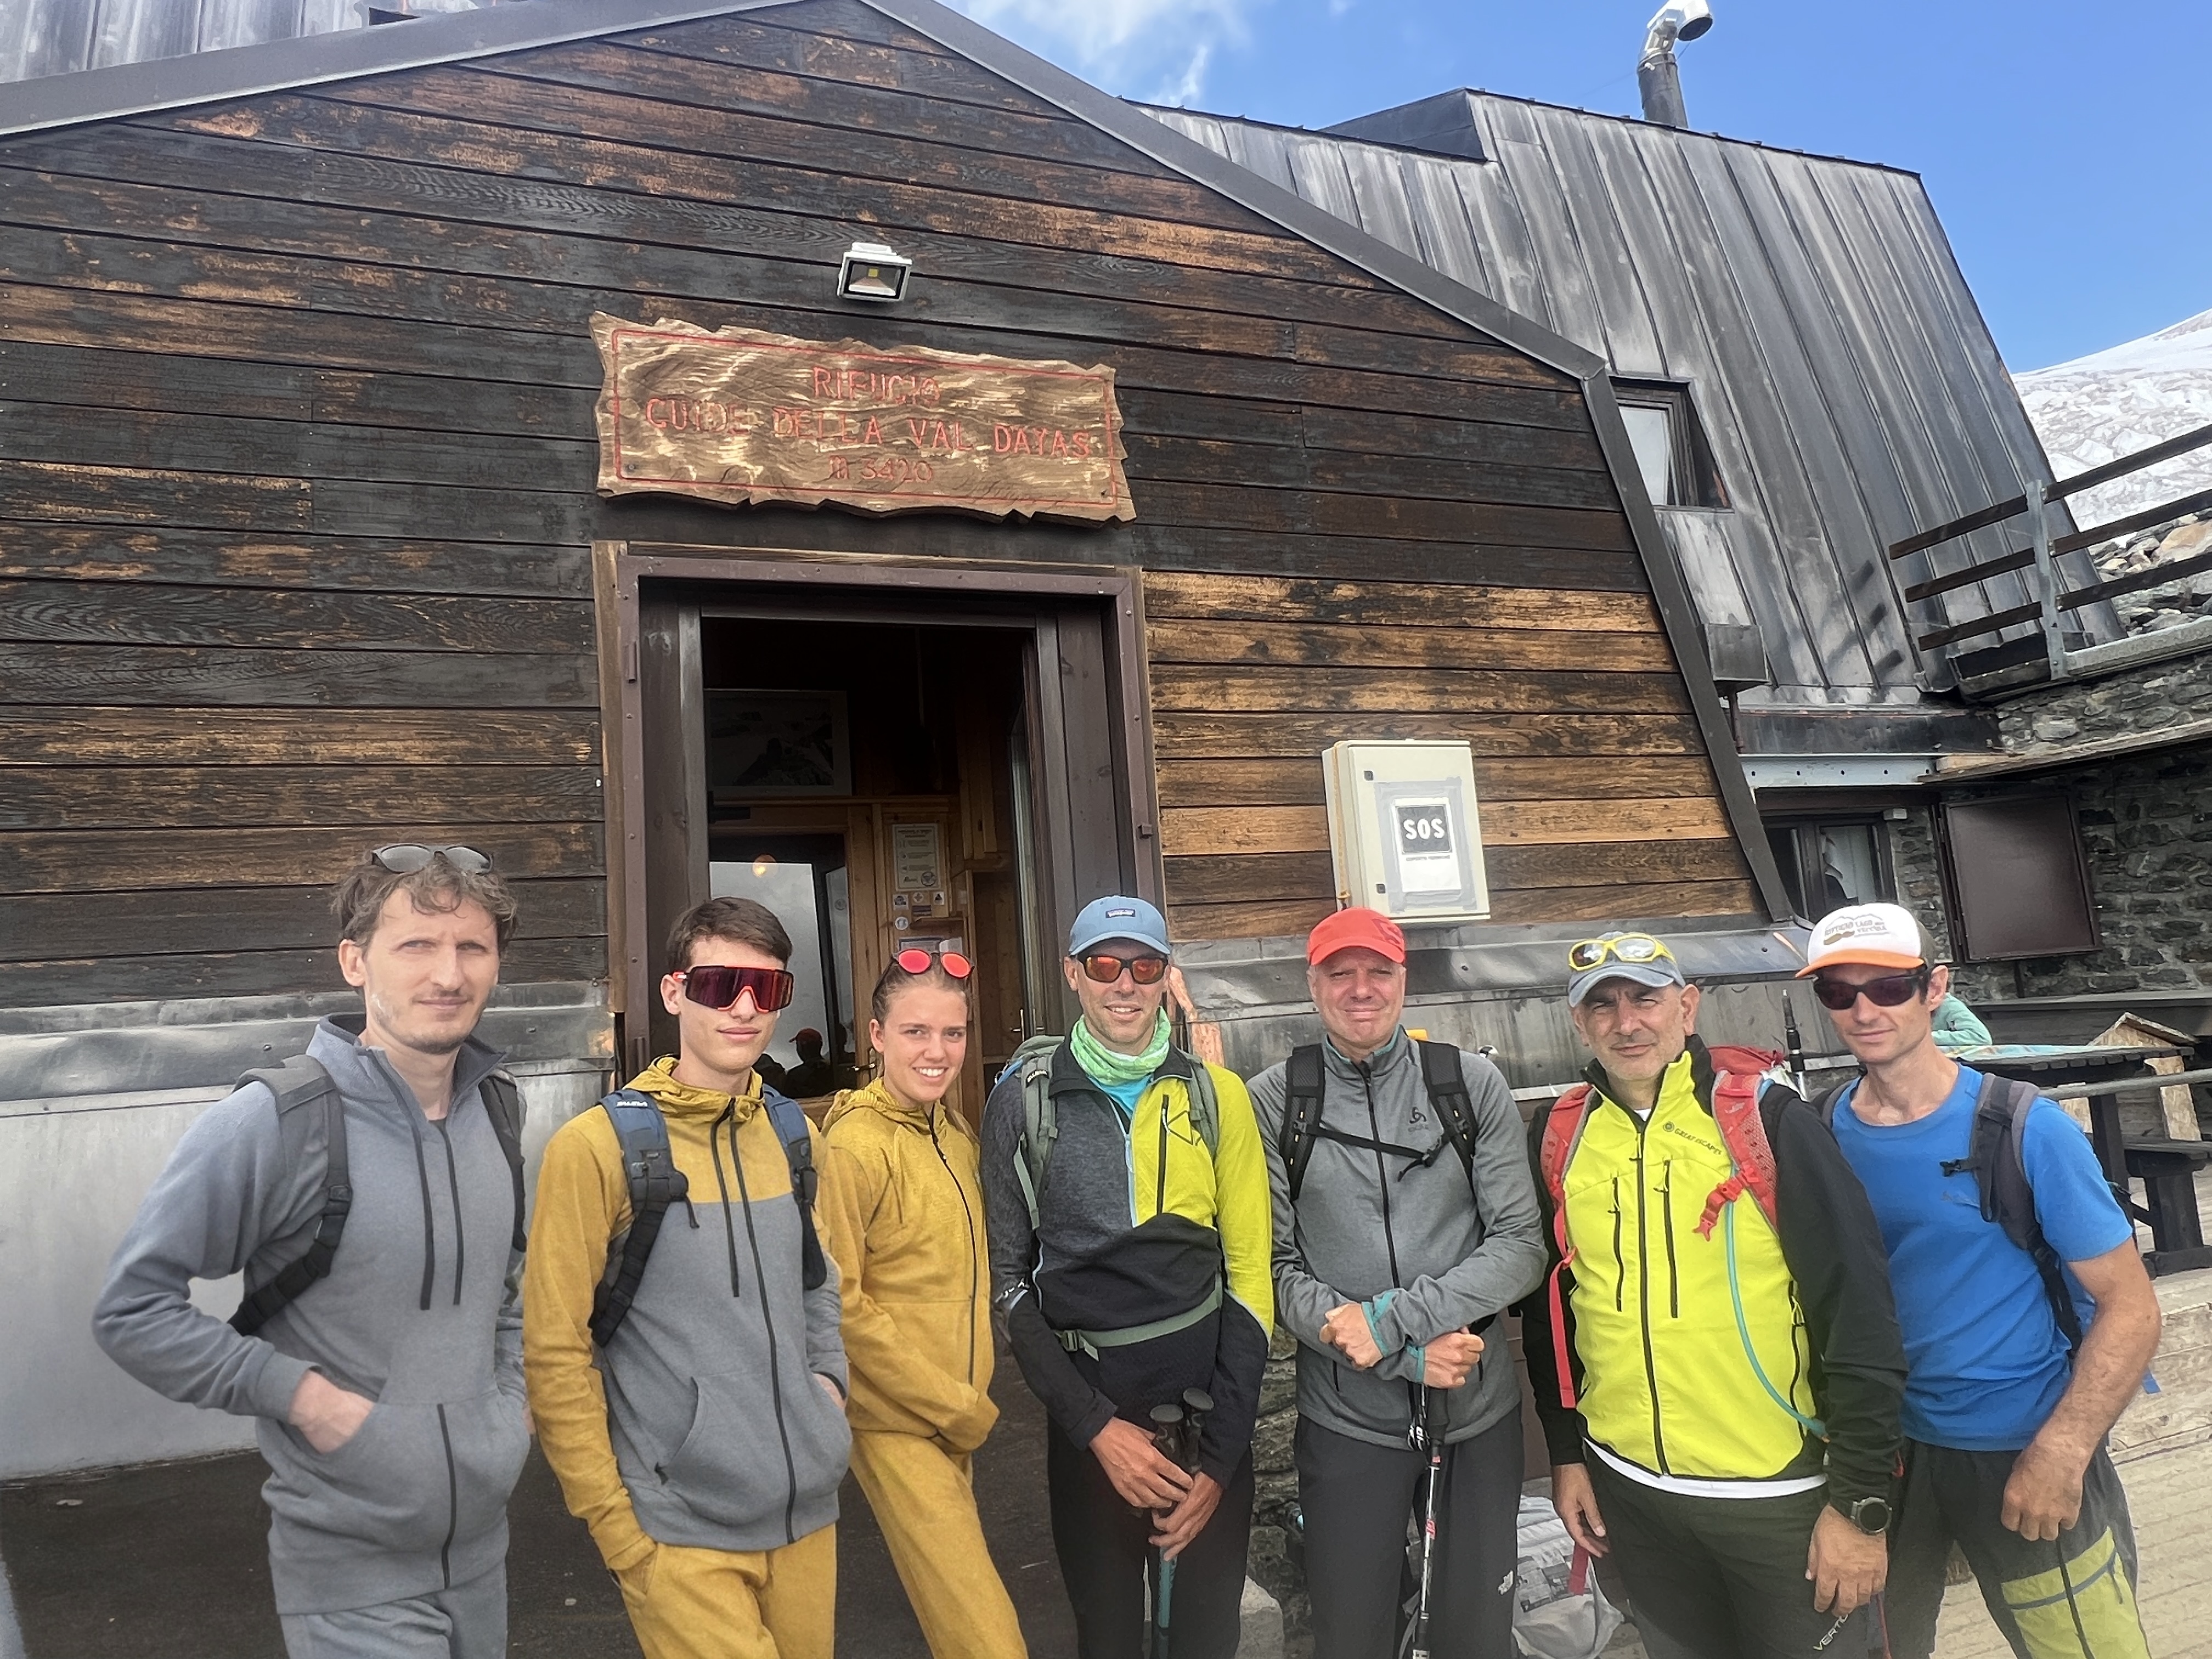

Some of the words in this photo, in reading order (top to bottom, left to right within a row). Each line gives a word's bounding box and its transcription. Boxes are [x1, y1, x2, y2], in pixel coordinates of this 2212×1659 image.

[772, 407, 885, 444] DELLA
[905, 416, 972, 452] VAL
[859, 456, 933, 483] 3420
[1403, 818, 1445, 840] SOS
